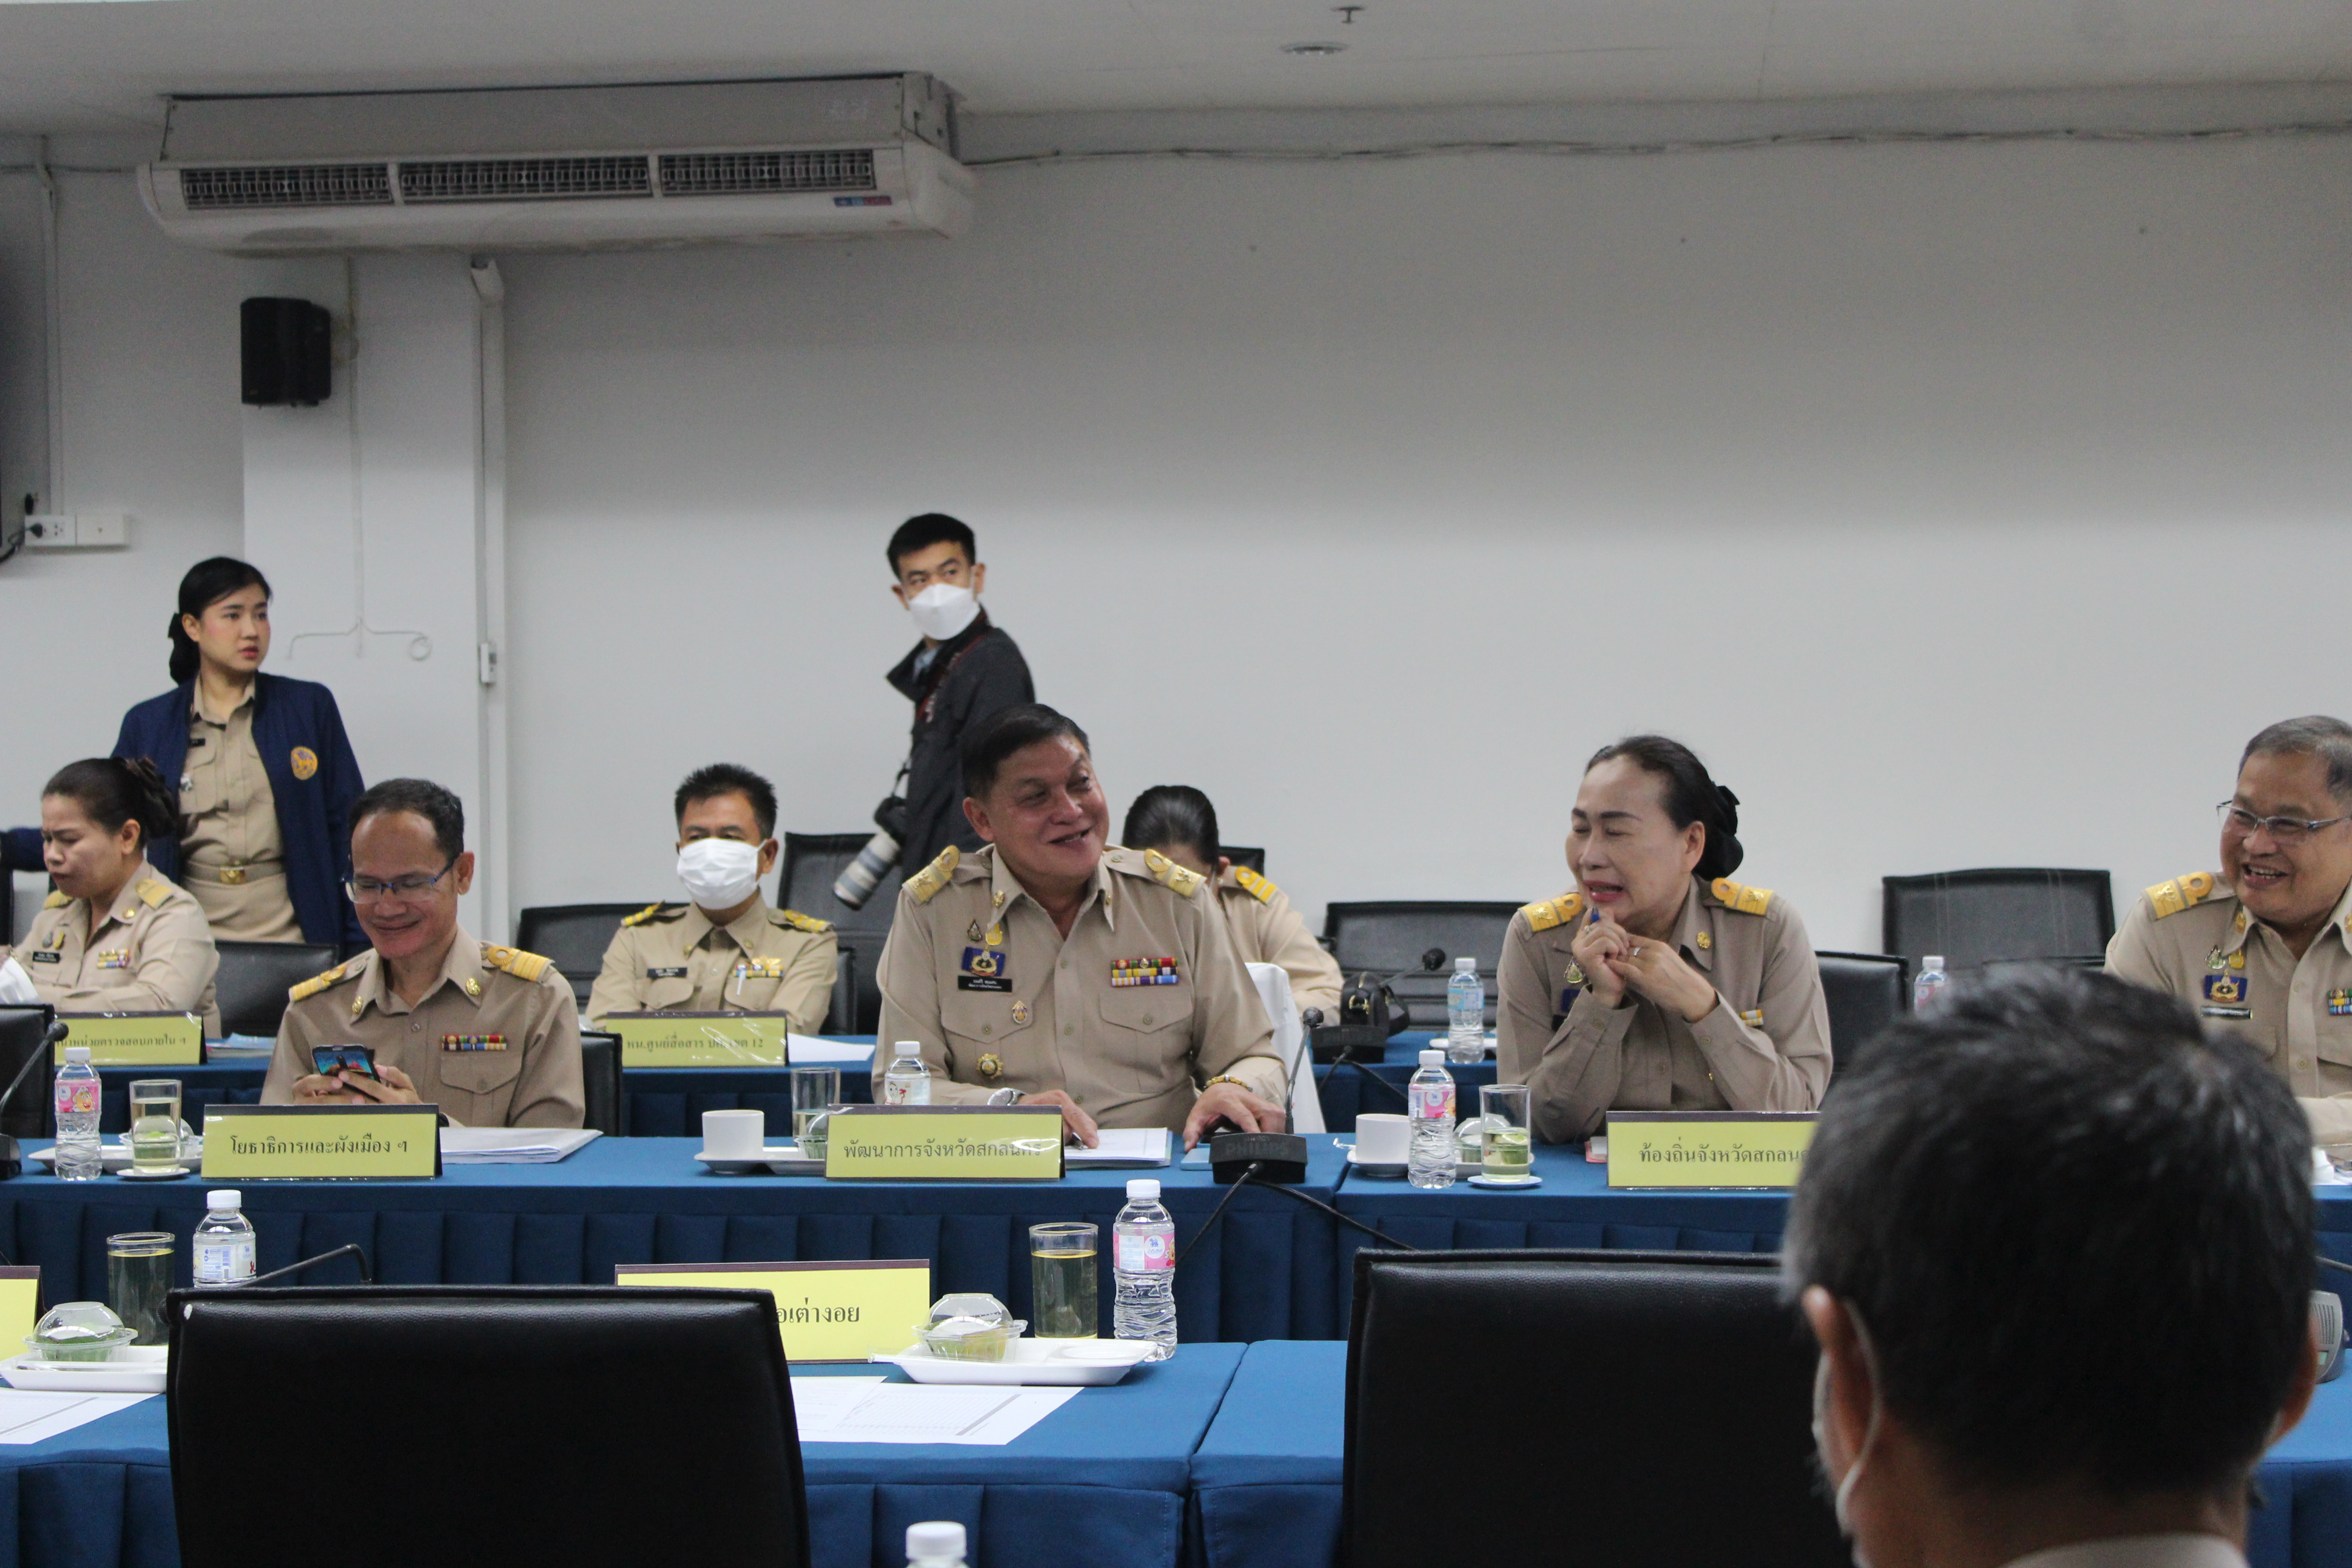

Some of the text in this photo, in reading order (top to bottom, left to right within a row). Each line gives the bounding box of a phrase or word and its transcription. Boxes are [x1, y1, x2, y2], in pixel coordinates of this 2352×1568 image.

[752, 1038, 763, 1048] 12
[230, 1133, 391, 1155] โยธาธิการและผังเมือง
